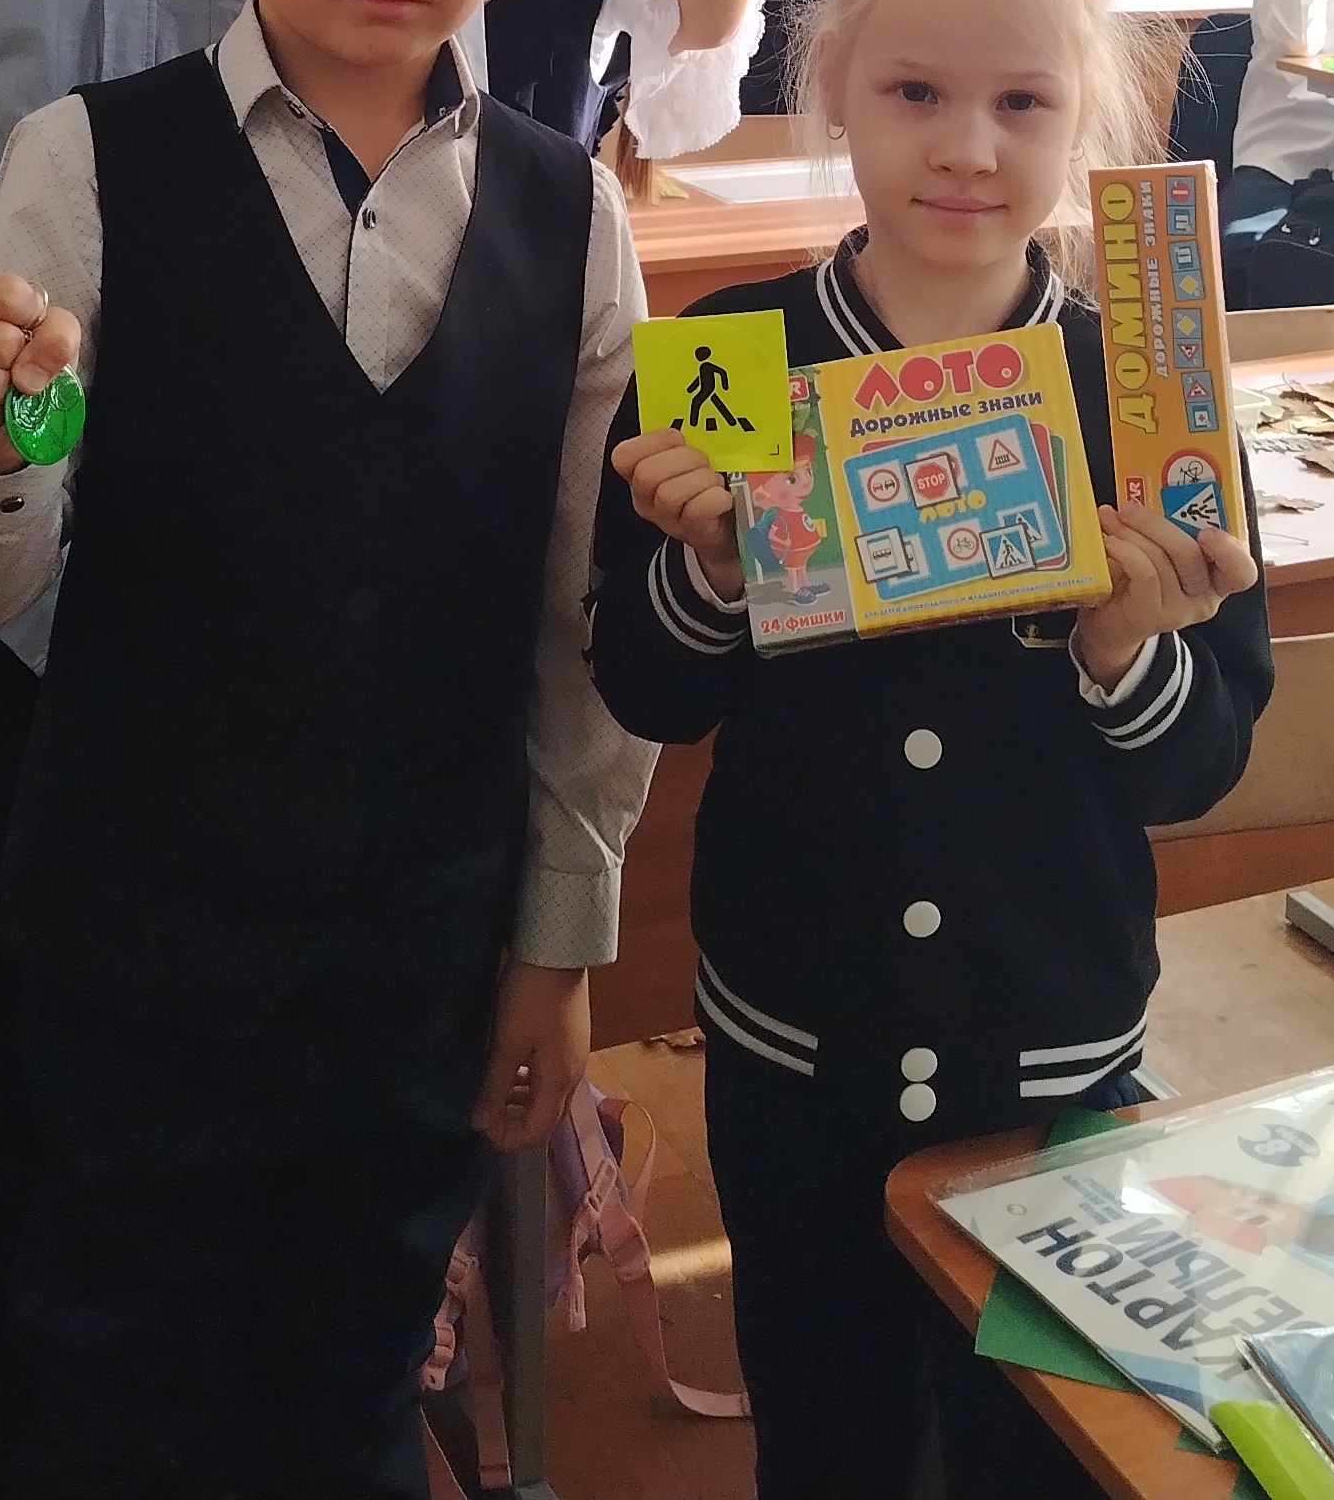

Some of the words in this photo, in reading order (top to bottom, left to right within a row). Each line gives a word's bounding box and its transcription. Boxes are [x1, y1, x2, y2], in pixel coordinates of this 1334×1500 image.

[1140, 181, 1156, 247] ЗНАКИ
[1100, 182, 1158, 434] ДОМИНО
[1146, 257, 1169, 378] ДОРОЖНЫЕ
[854, 342, 1024, 411] ЛОТО
[849, 402, 973, 438] Дорожные
[978, 391, 1044, 414] знаки
[917, 472, 946, 491] STOP
[919, 489, 988, 525] ЛОТО
[759, 619, 782, 635] 24
[785, 610, 845, 633] фишки
